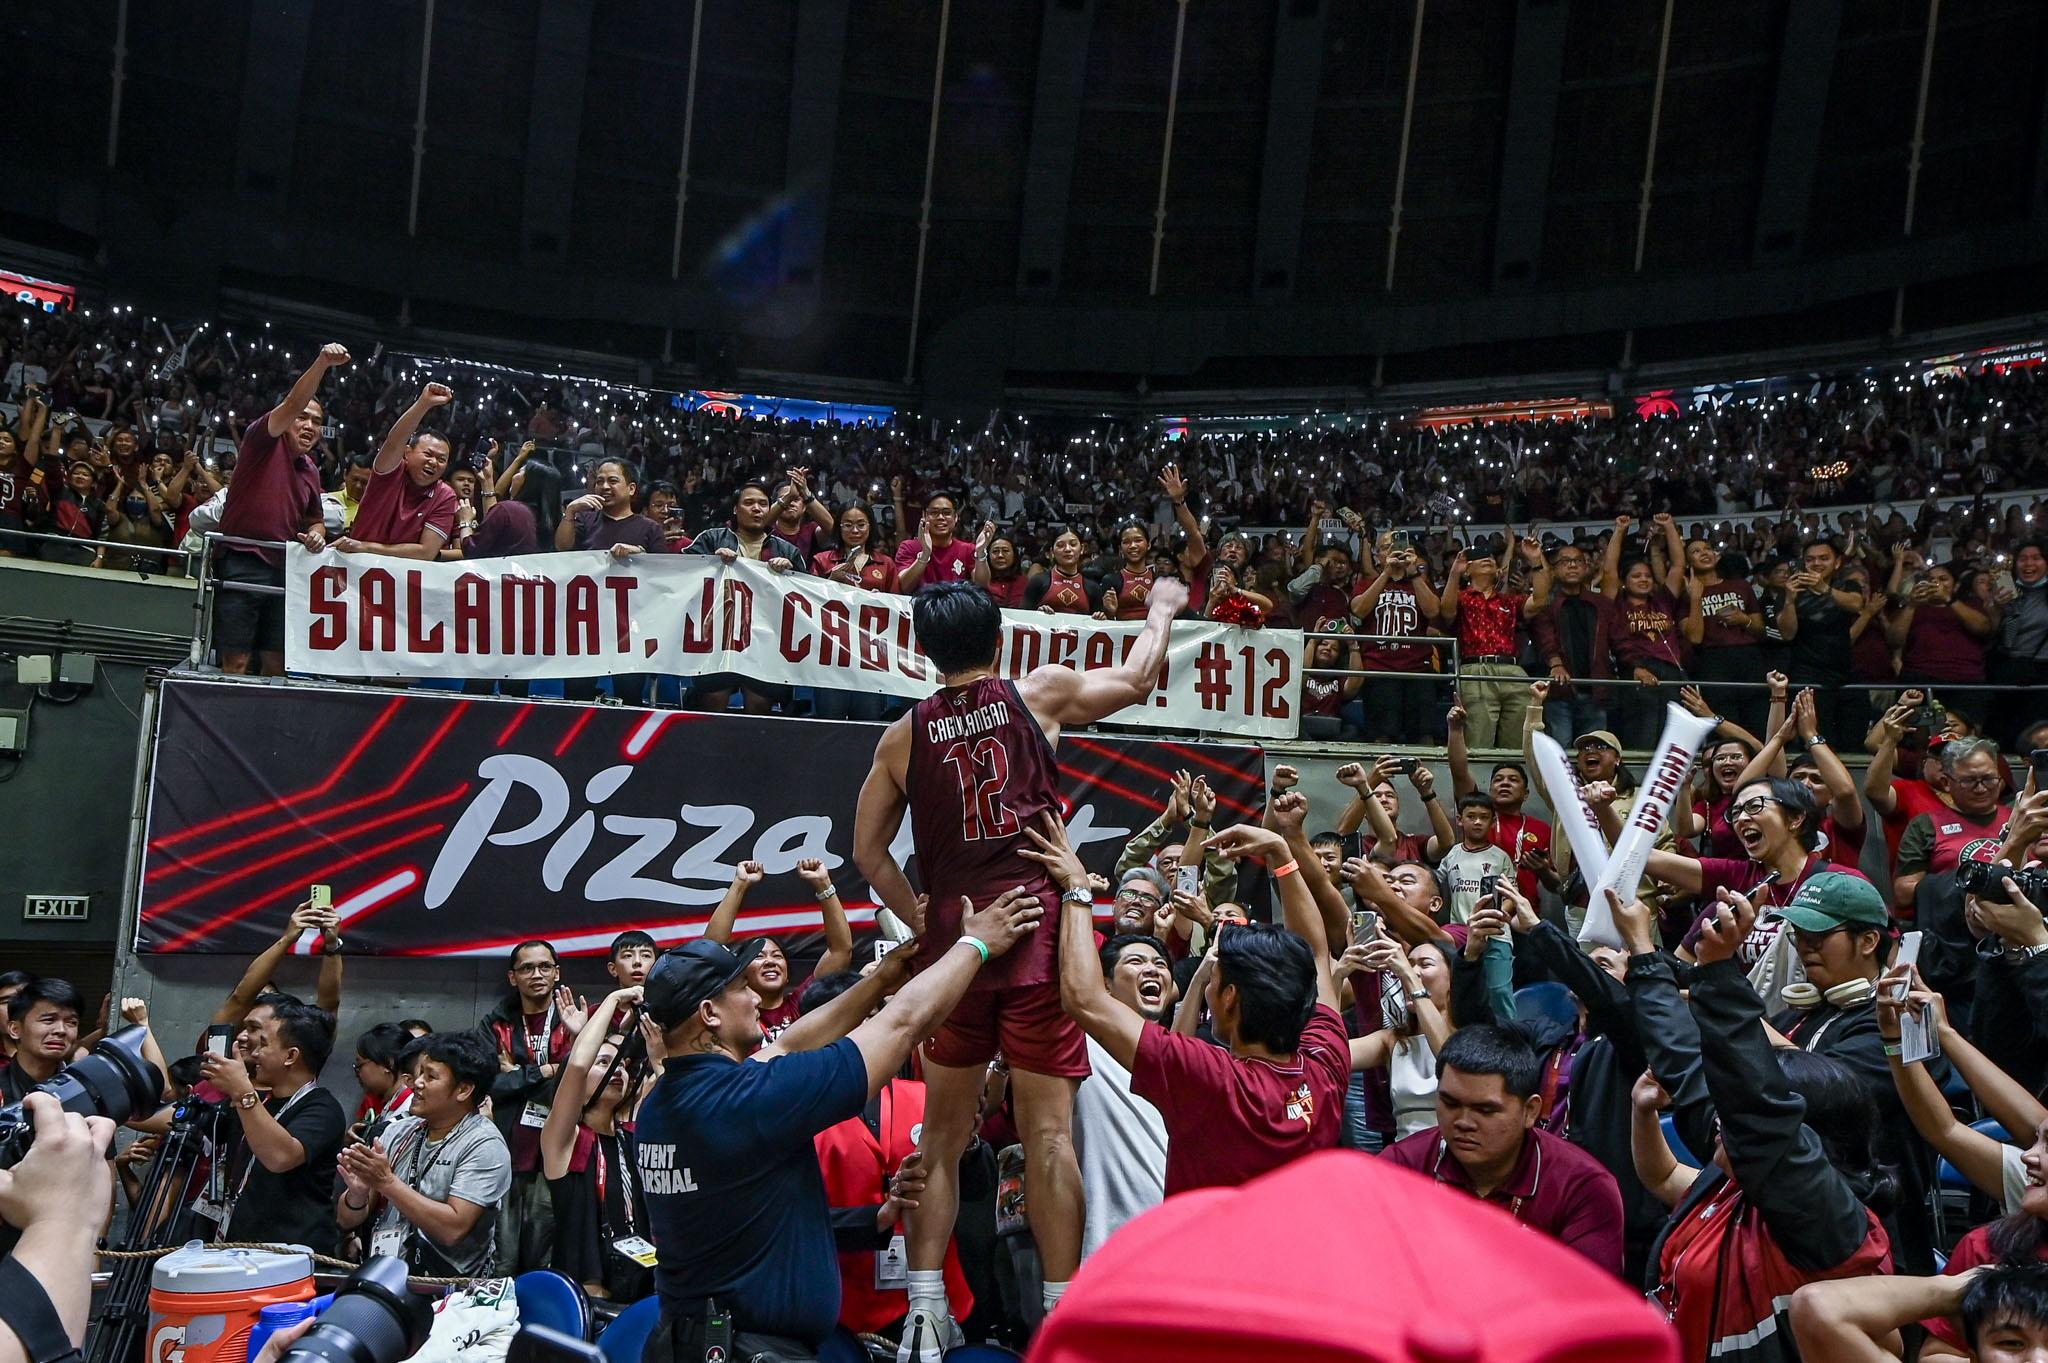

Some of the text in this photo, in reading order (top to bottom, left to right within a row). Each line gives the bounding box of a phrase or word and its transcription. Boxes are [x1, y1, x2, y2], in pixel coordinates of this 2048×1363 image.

[1378, 592, 1416, 607] TEAM
[309, 565, 659, 659] SALAMAT,
[683, 577, 753, 653] JD
[1195, 641, 1291, 718] #12
[1375, 602, 1418, 643] UP
[928, 701, 1010, 744] CAGULANGAN
[943, 736, 1021, 841] 12
[1634, 742, 1690, 834] UP FIGHT
[424, 754, 843, 909] Pizza
[1455, 877, 1480, 888] Team
[34, 900, 79, 916] EXIT
